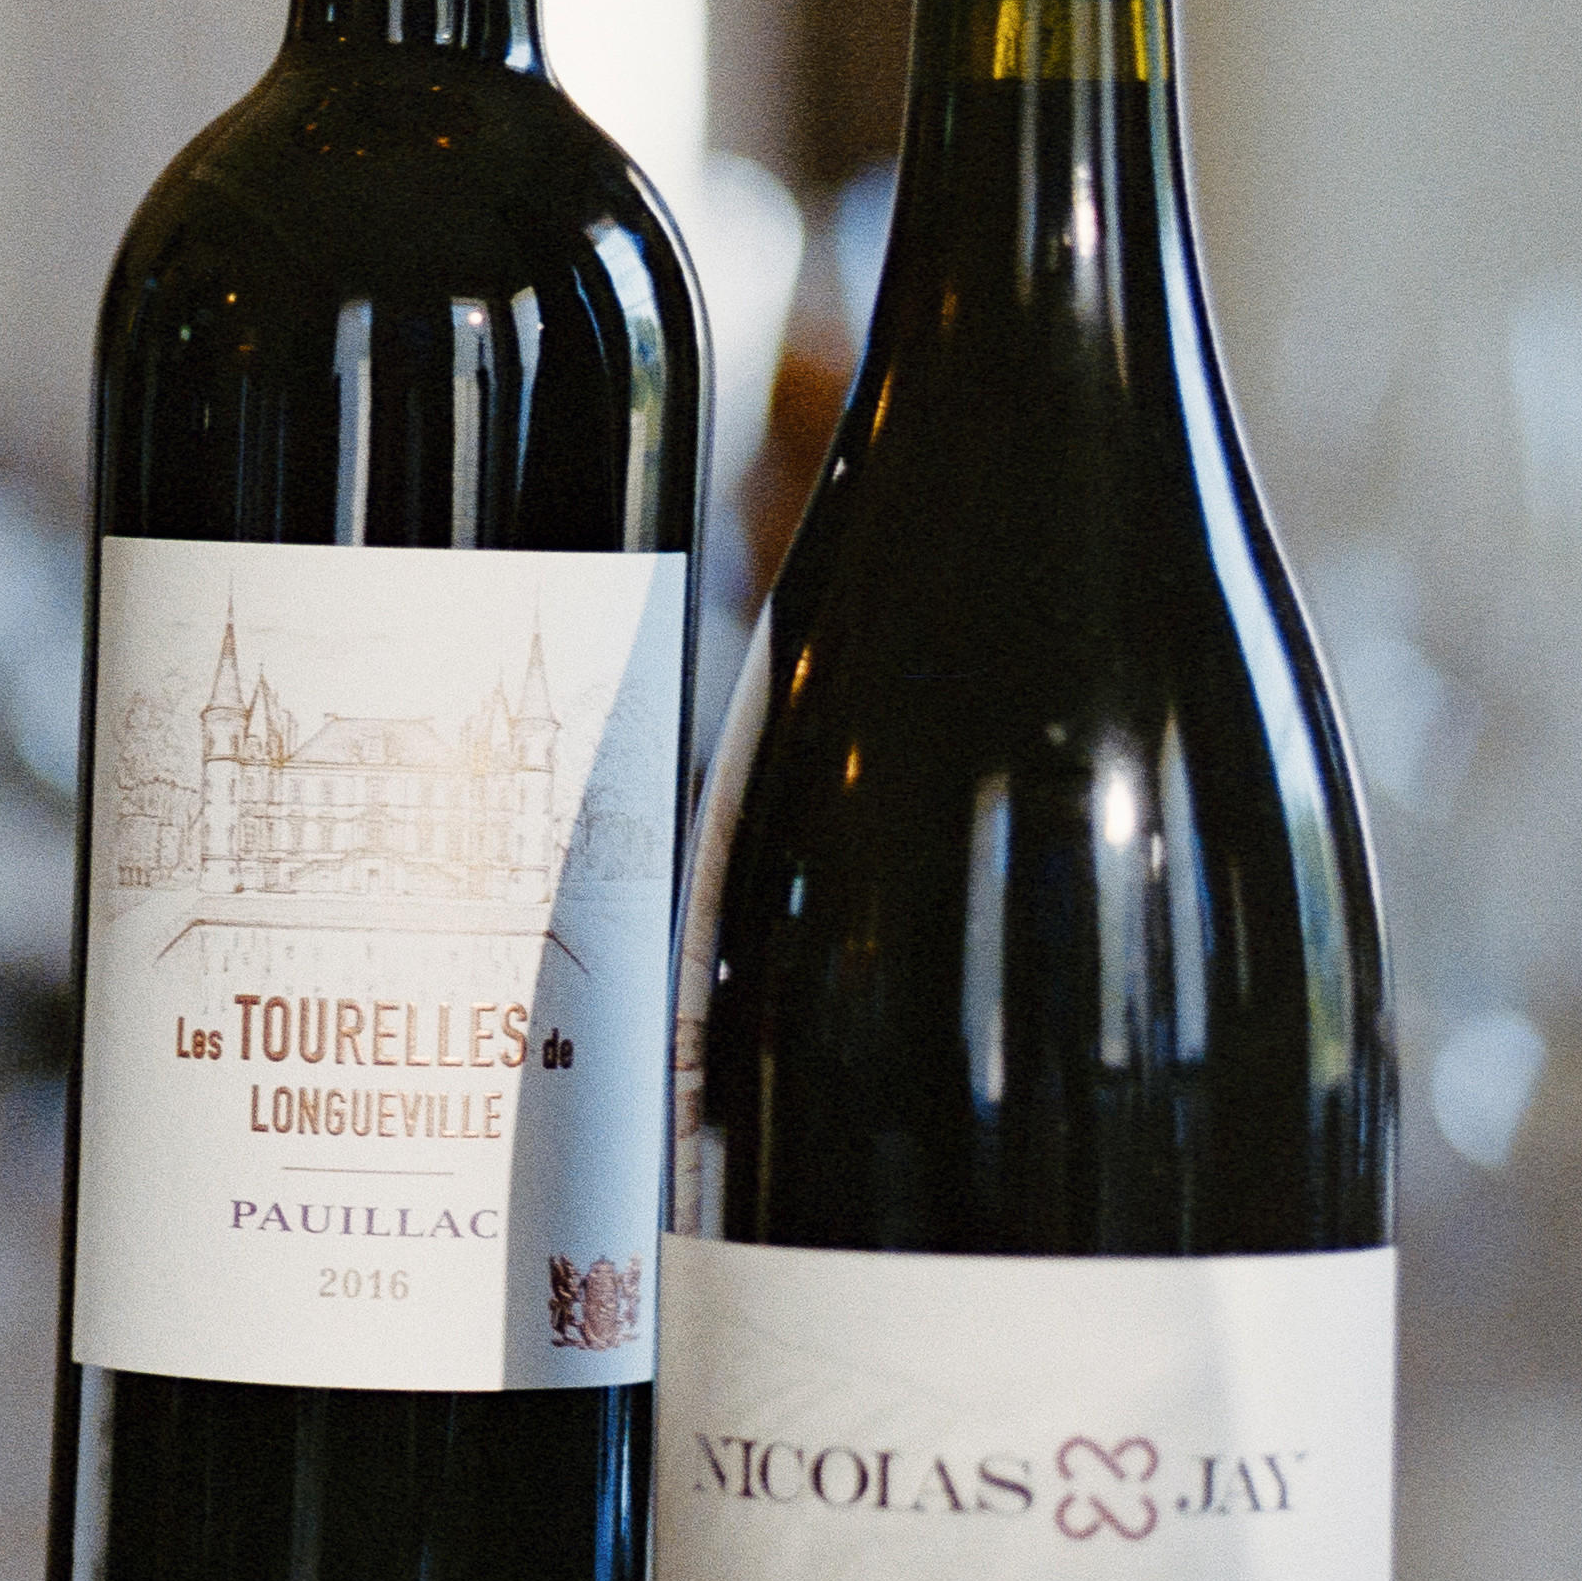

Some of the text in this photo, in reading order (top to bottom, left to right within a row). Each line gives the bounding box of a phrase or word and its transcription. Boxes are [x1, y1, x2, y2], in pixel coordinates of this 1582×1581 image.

[176, 993, 573, 1069] Les TOURELLES de
[250, 1084, 503, 1139] LONGUEVILLE
[229, 1199, 499, 1240] PAUILLAC
[318, 1267, 410, 1300] 2016
[692, 1432, 1307, 1515] NICOLAS JAY
